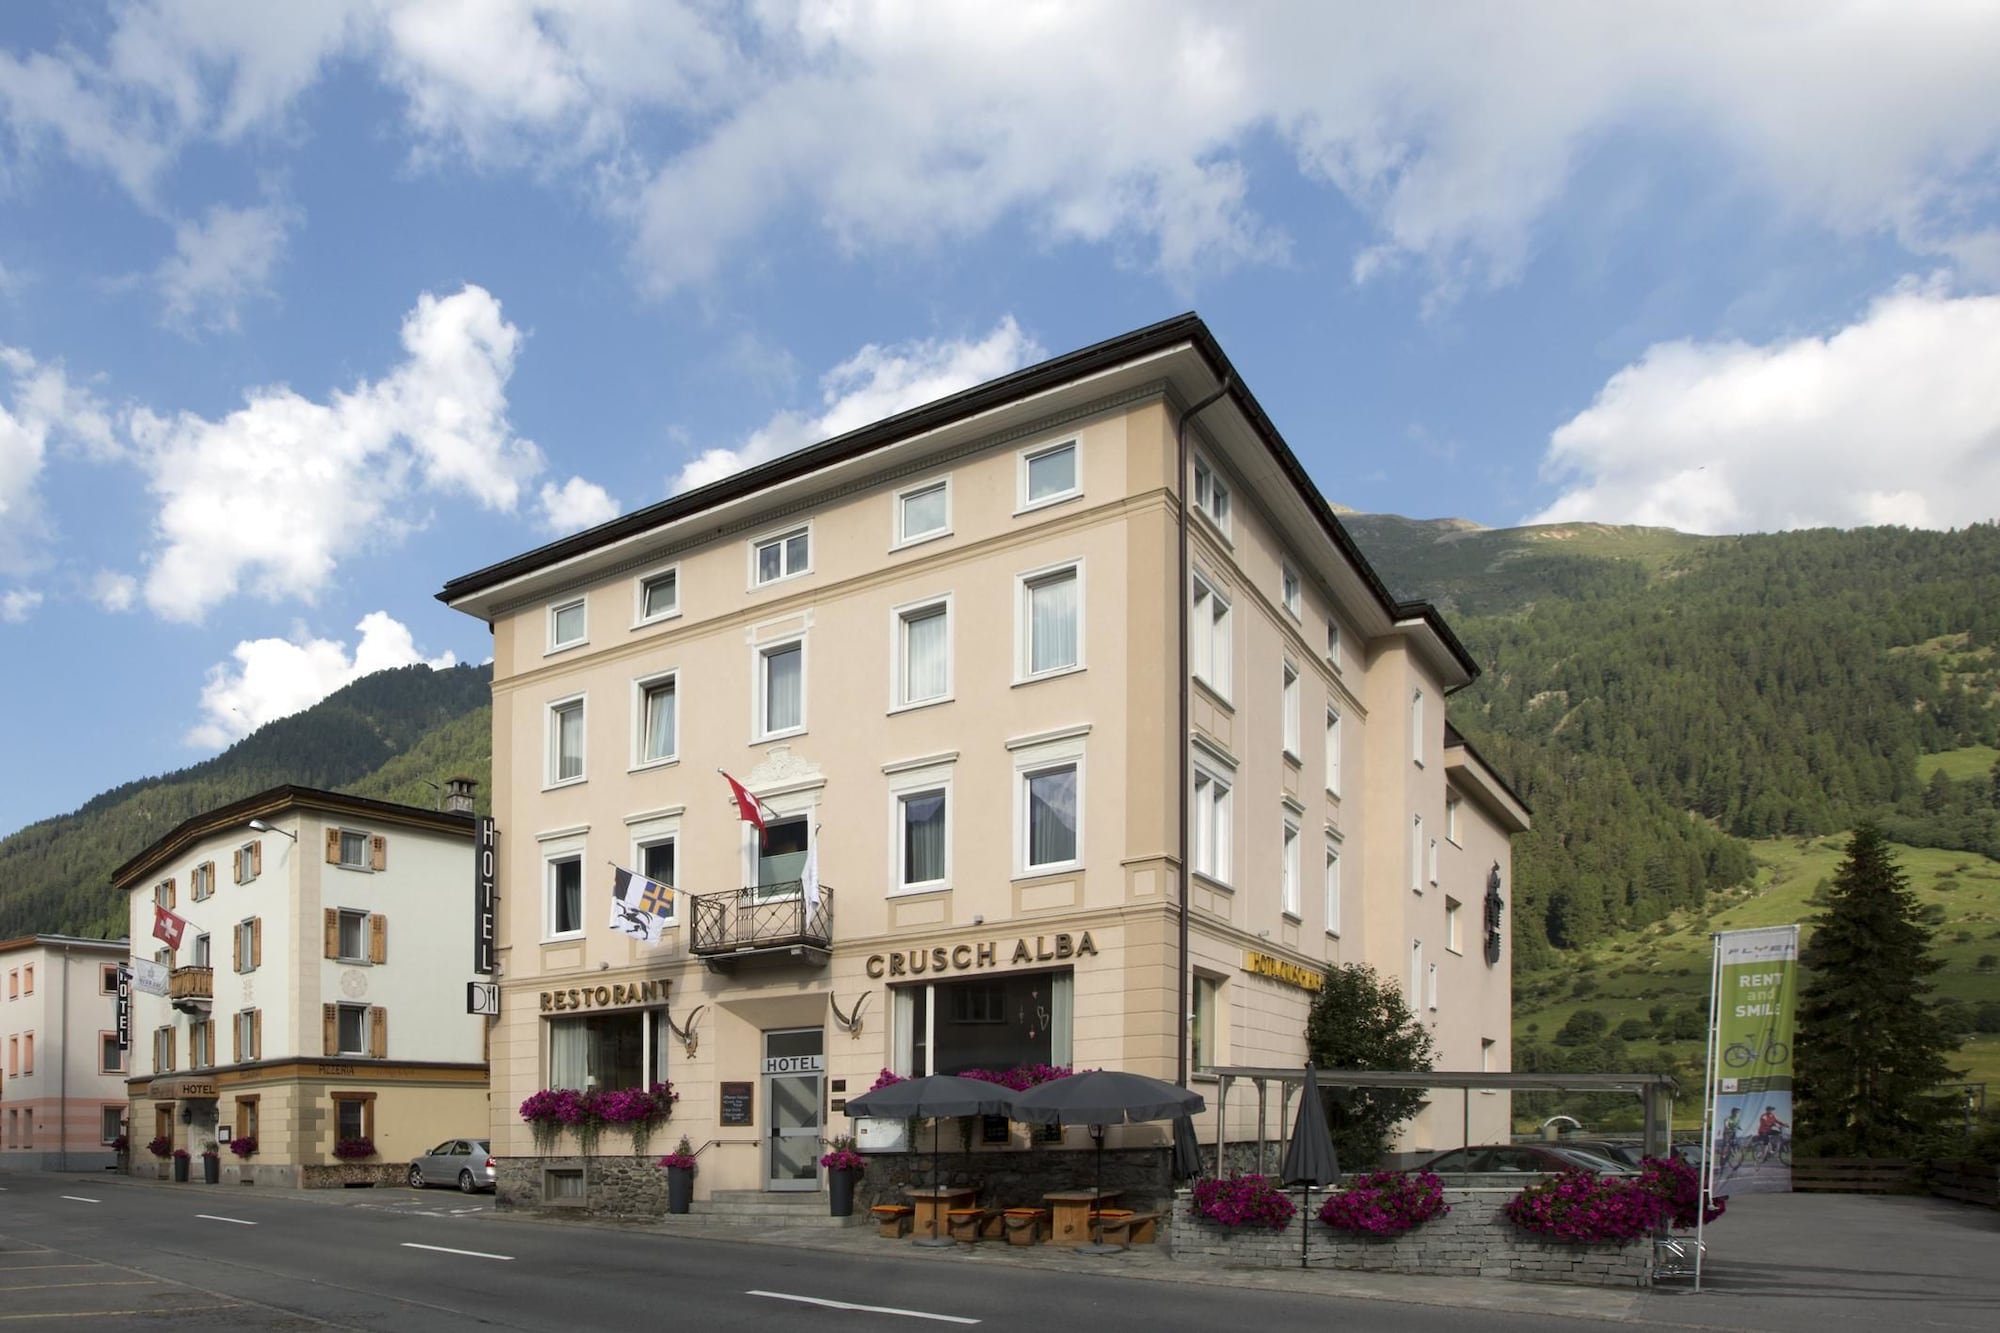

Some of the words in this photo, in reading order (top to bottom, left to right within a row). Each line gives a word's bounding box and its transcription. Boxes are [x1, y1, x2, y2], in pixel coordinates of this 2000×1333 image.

[483, 819, 494, 971] HOTEL
[866, 942, 997, 979] CRUSCH
[1012, 931, 1099, 964] ALBA
[1739, 972, 1784, 988] RENT
[540, 979, 673, 1012] RESTORANT
[1747, 986, 1777, 1001] and
[318, 1063, 355, 1076] PIZZERIA
[767, 1056, 820, 1072] HOTEL
[183, 1084, 217, 1095] HOTEL
